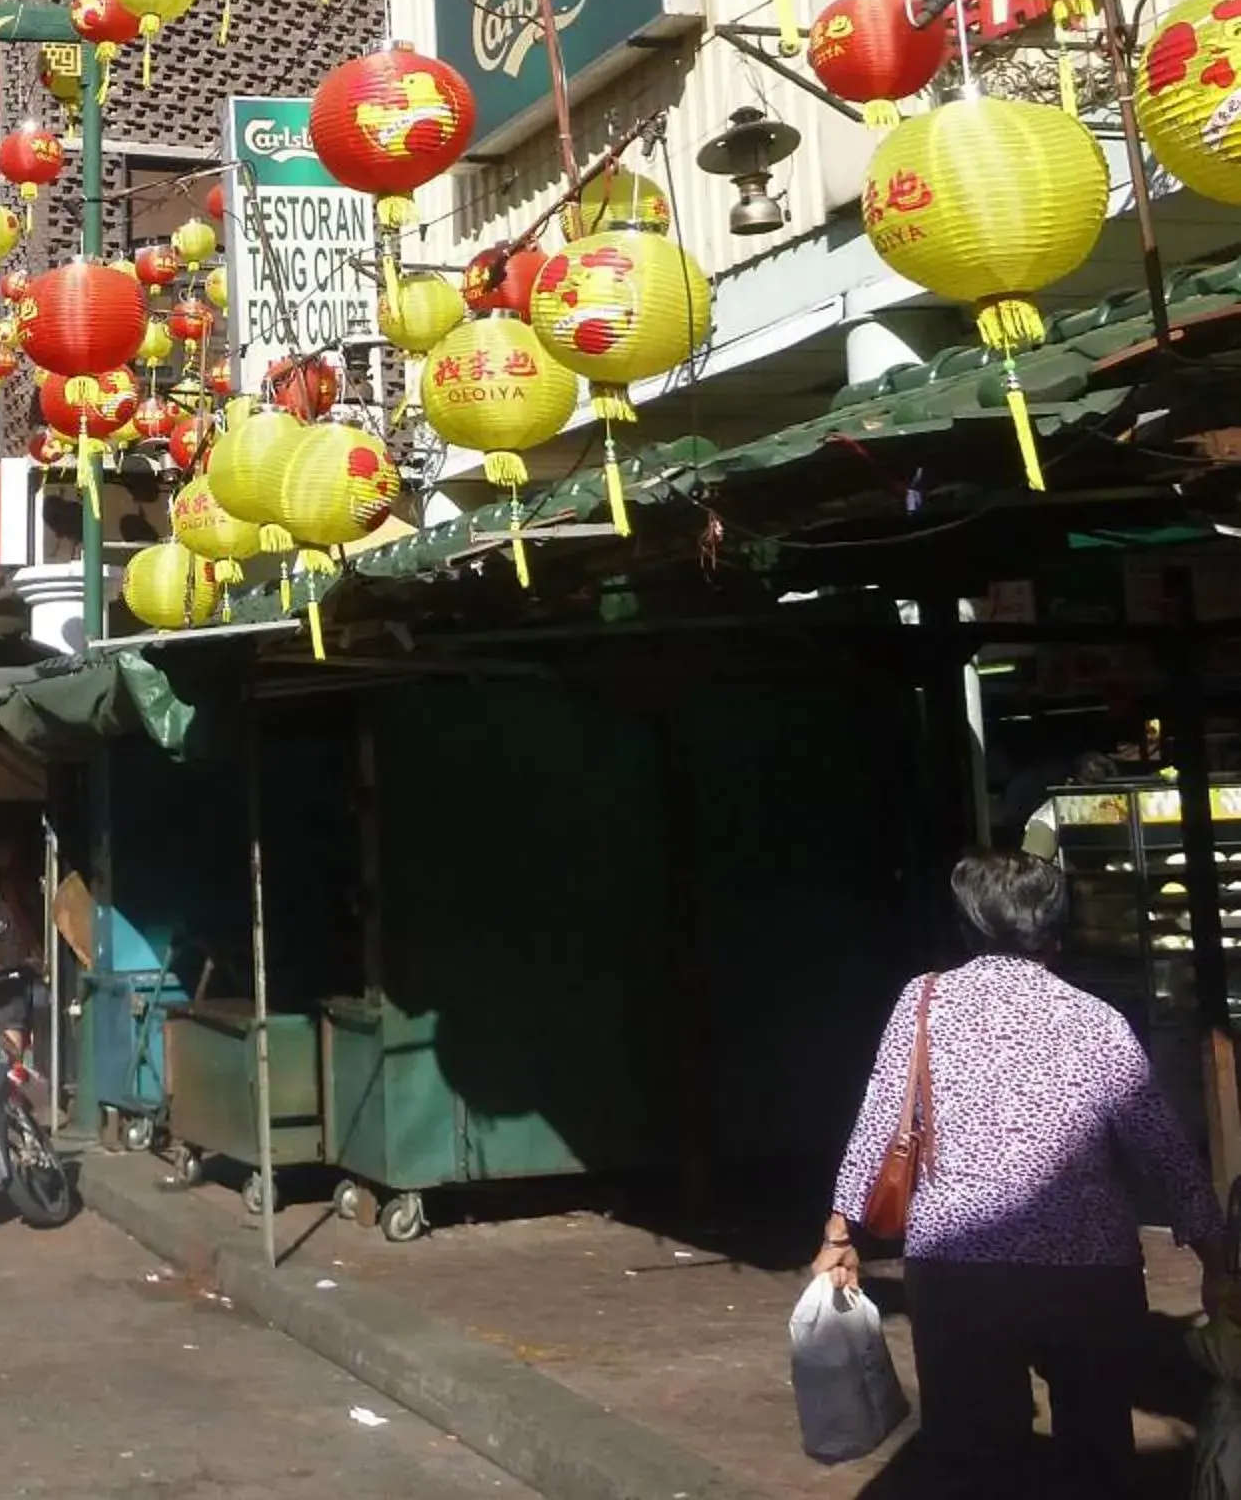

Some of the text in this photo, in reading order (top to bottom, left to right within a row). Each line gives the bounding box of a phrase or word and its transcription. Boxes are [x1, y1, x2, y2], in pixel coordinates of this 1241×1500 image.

[243, 195, 366, 241] RESTORAN
[247, 247, 363, 293] TANG CITY
[448, 386, 526, 403] OLOIYA
